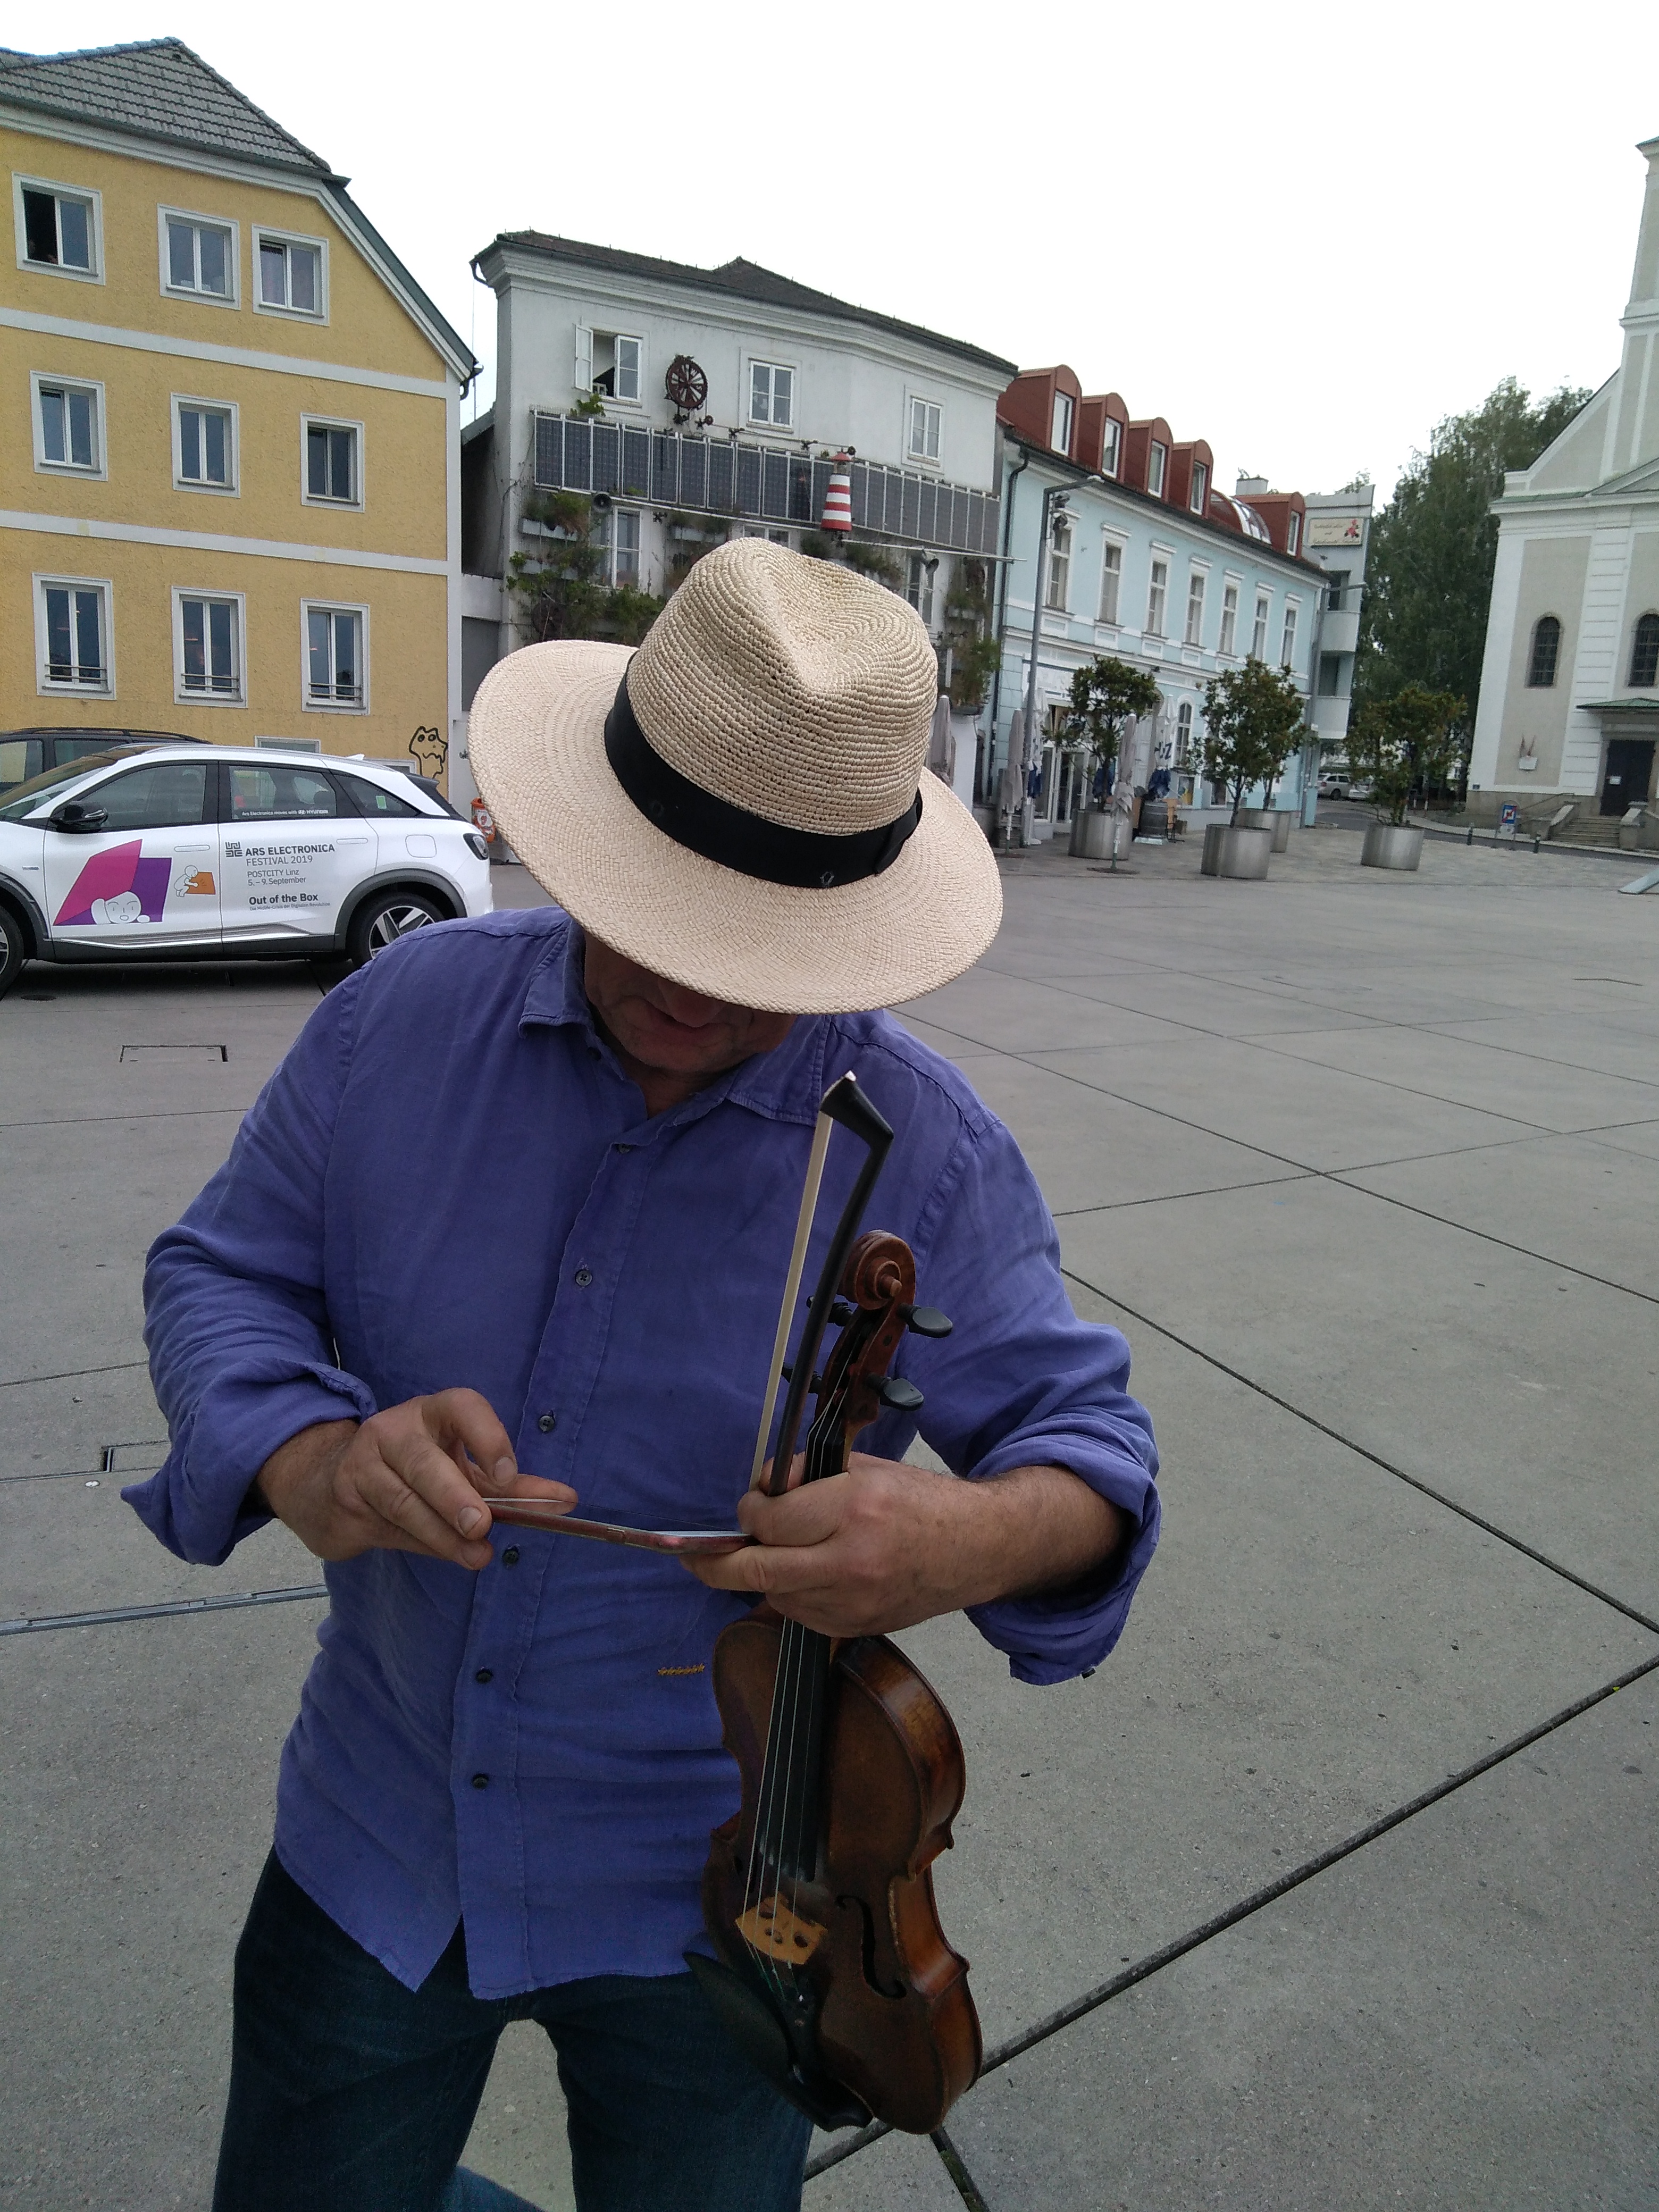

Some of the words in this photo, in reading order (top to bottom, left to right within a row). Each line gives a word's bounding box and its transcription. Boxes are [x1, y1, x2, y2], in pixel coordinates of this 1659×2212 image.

[245, 848, 265, 856] ARS
[267, 844, 335, 855] ELECTRONICA
[246, 857, 289, 866] FESTIVAL
[291, 855, 313, 864] 2019
[269, 877, 306, 886] September
[249, 896, 267, 905] Out
[269, 895, 279, 903] of
[281, 894, 297, 902] the
